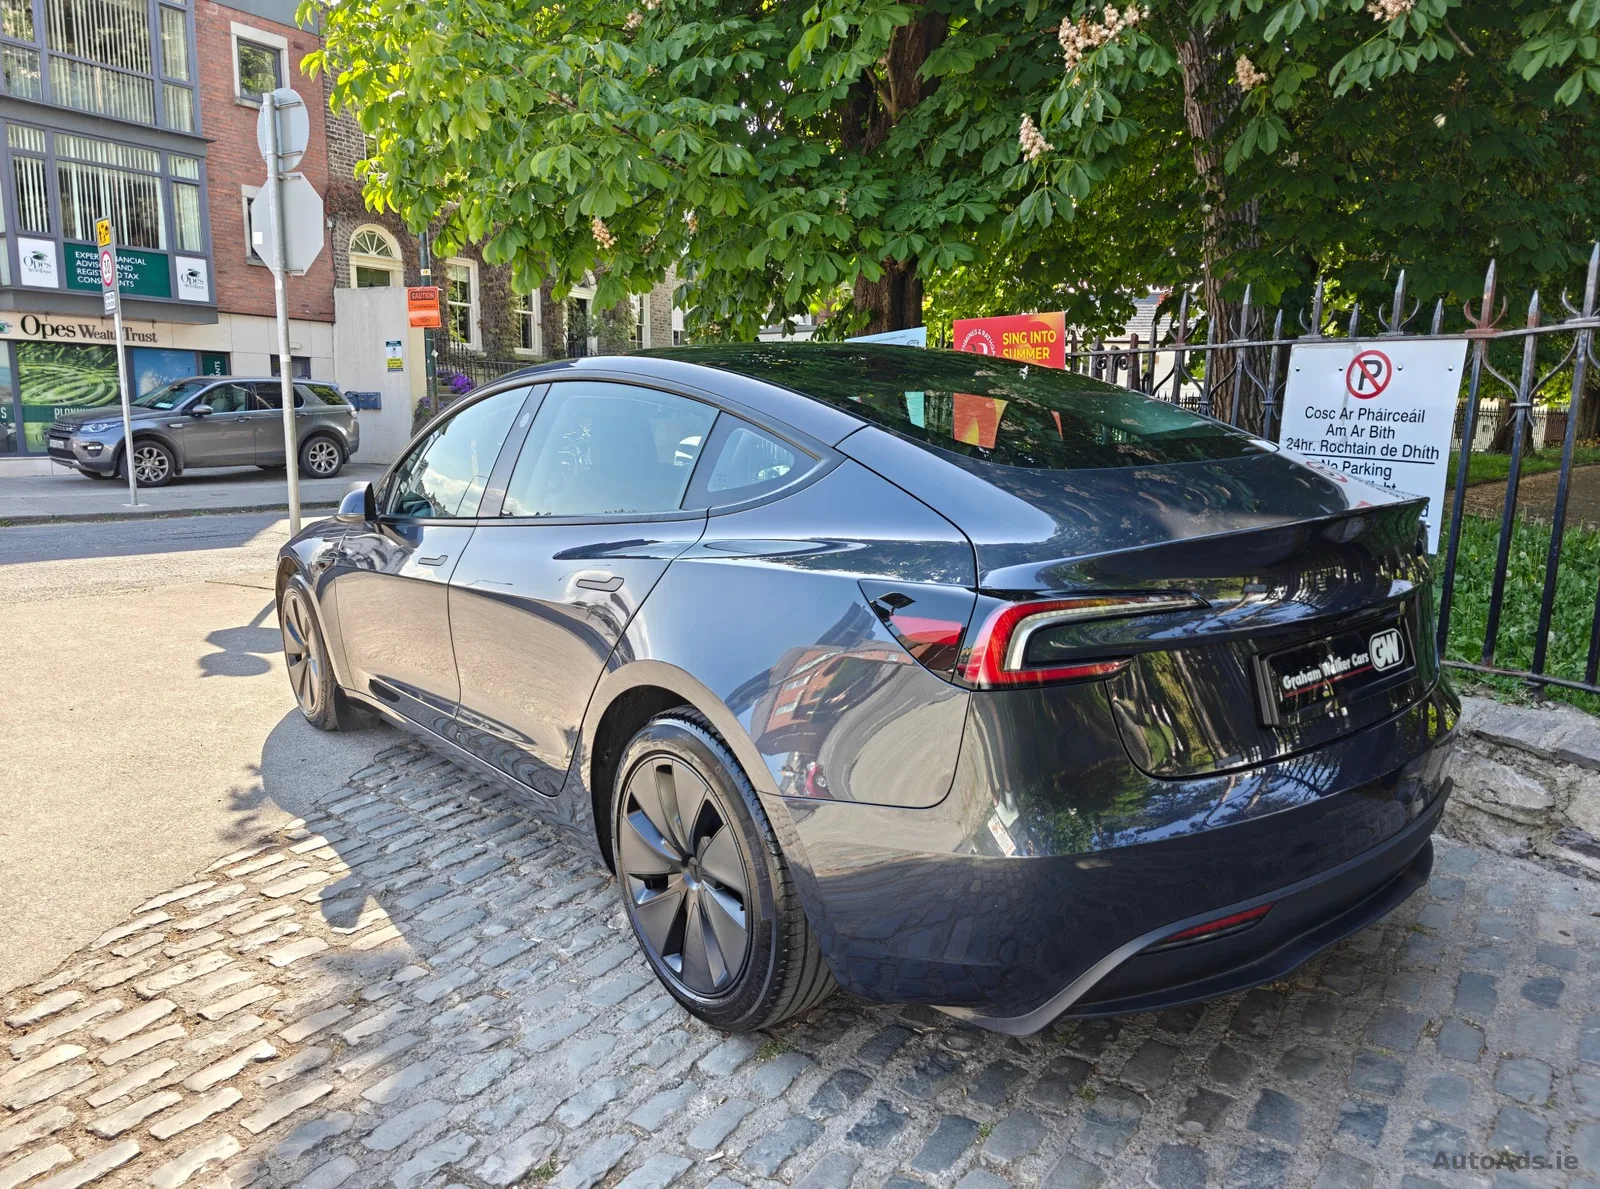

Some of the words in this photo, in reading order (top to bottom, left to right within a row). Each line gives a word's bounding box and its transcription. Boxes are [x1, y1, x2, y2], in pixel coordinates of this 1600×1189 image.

[23, 256, 52, 269] Opes
[75, 251, 100, 260] EXPER
[76, 267, 123, 278] REGISTD
[123, 272, 140, 280] TAX
[77, 276, 135, 288] CONSNTS
[411, 291, 435, 300] CAUTION
[20, 314, 76, 339] Opes
[77, 324, 117, 341] Wealt
[122, 326, 158, 343] Trust
[1002, 331, 1027, 346] SING
[1030, 329, 1057, 344] INTO
[1002, 346, 1050, 361] SUMMER
[1305, 406, 1336, 420] Cosc
[1339, 408, 1354, 420] Ar
[1358, 407, 1426, 423] Pháirceáil
[1325, 424, 1347, 437] Am
[1351, 425, 1366, 438] Ar
[1370, 426, 1396, 440] Bith
[1286, 437, 1316, 452] 24hr.
[1320, 440, 1376, 456] Rochtain
[1380, 443, 1398, 457] de
[1402, 444, 1440, 460] Dhíth
[1342, 461, 1392, 481] Parking
[1370, 631, 1400, 669] GW
[1282, 668, 1322, 690] Graham
[1351, 652, 1370, 666] Cars
